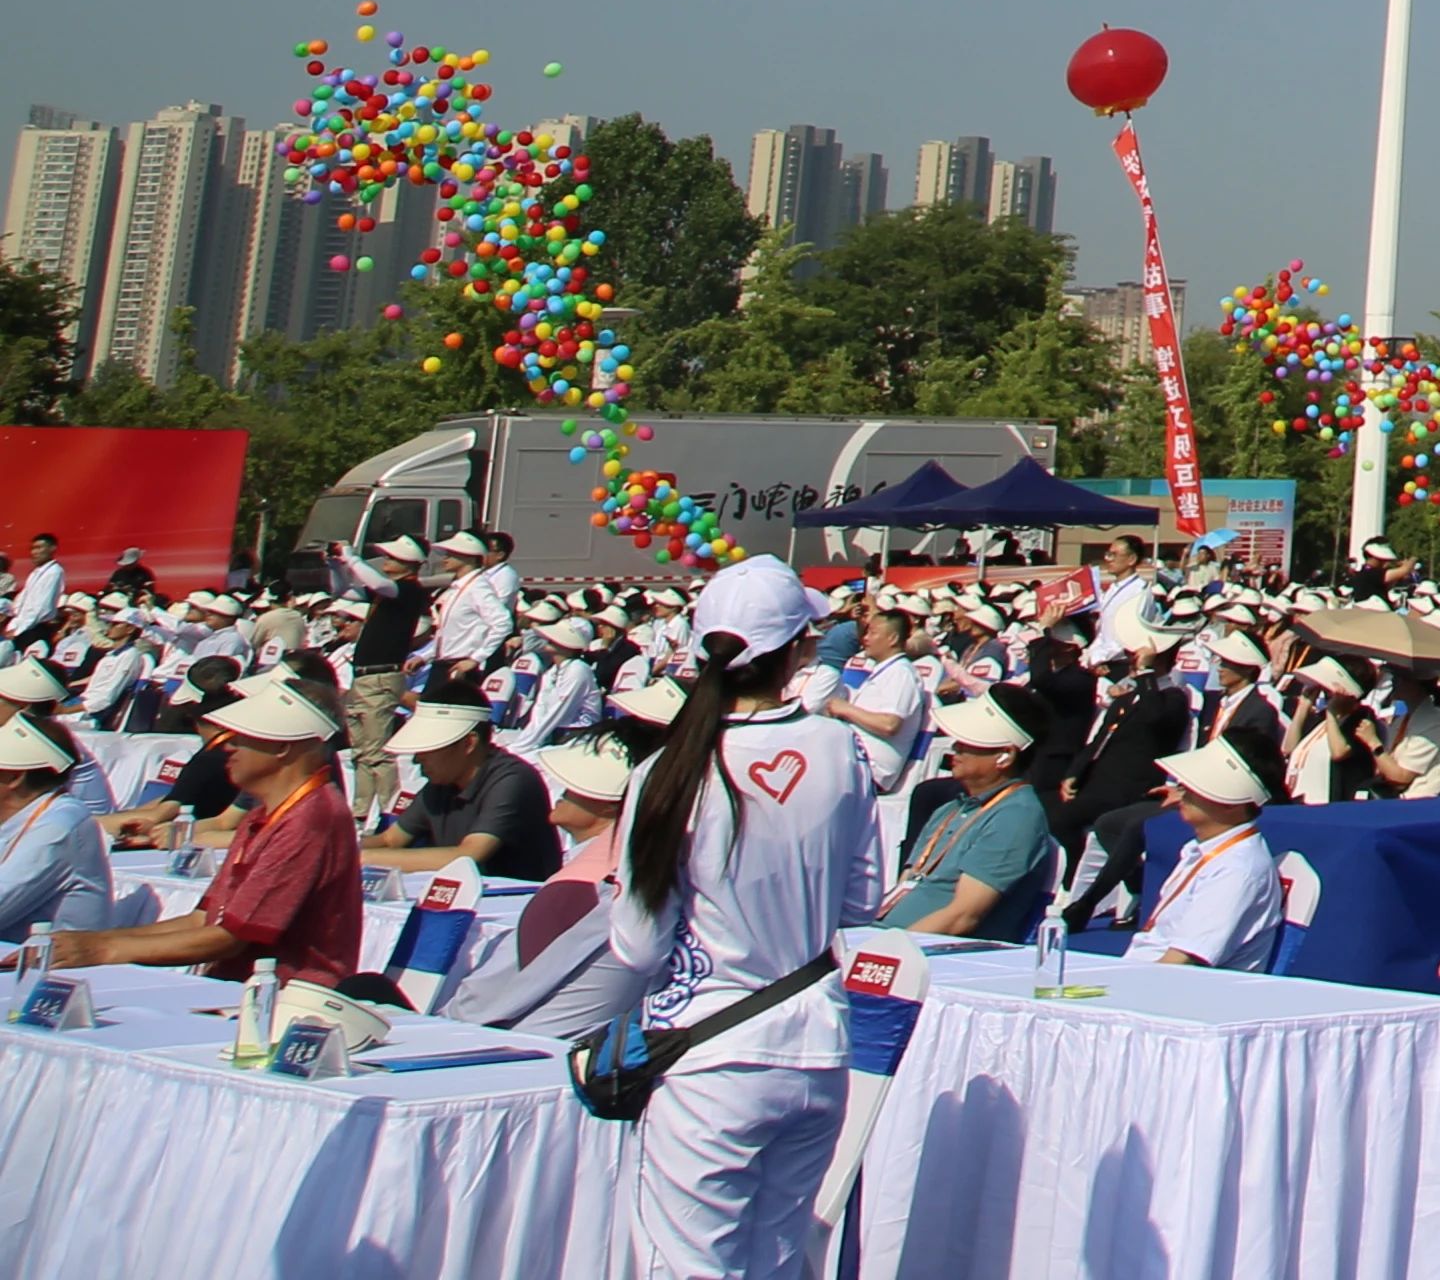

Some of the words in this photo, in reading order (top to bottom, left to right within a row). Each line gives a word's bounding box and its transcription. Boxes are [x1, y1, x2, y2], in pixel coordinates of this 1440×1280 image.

[687, 480, 888, 522] 三门峡电视
